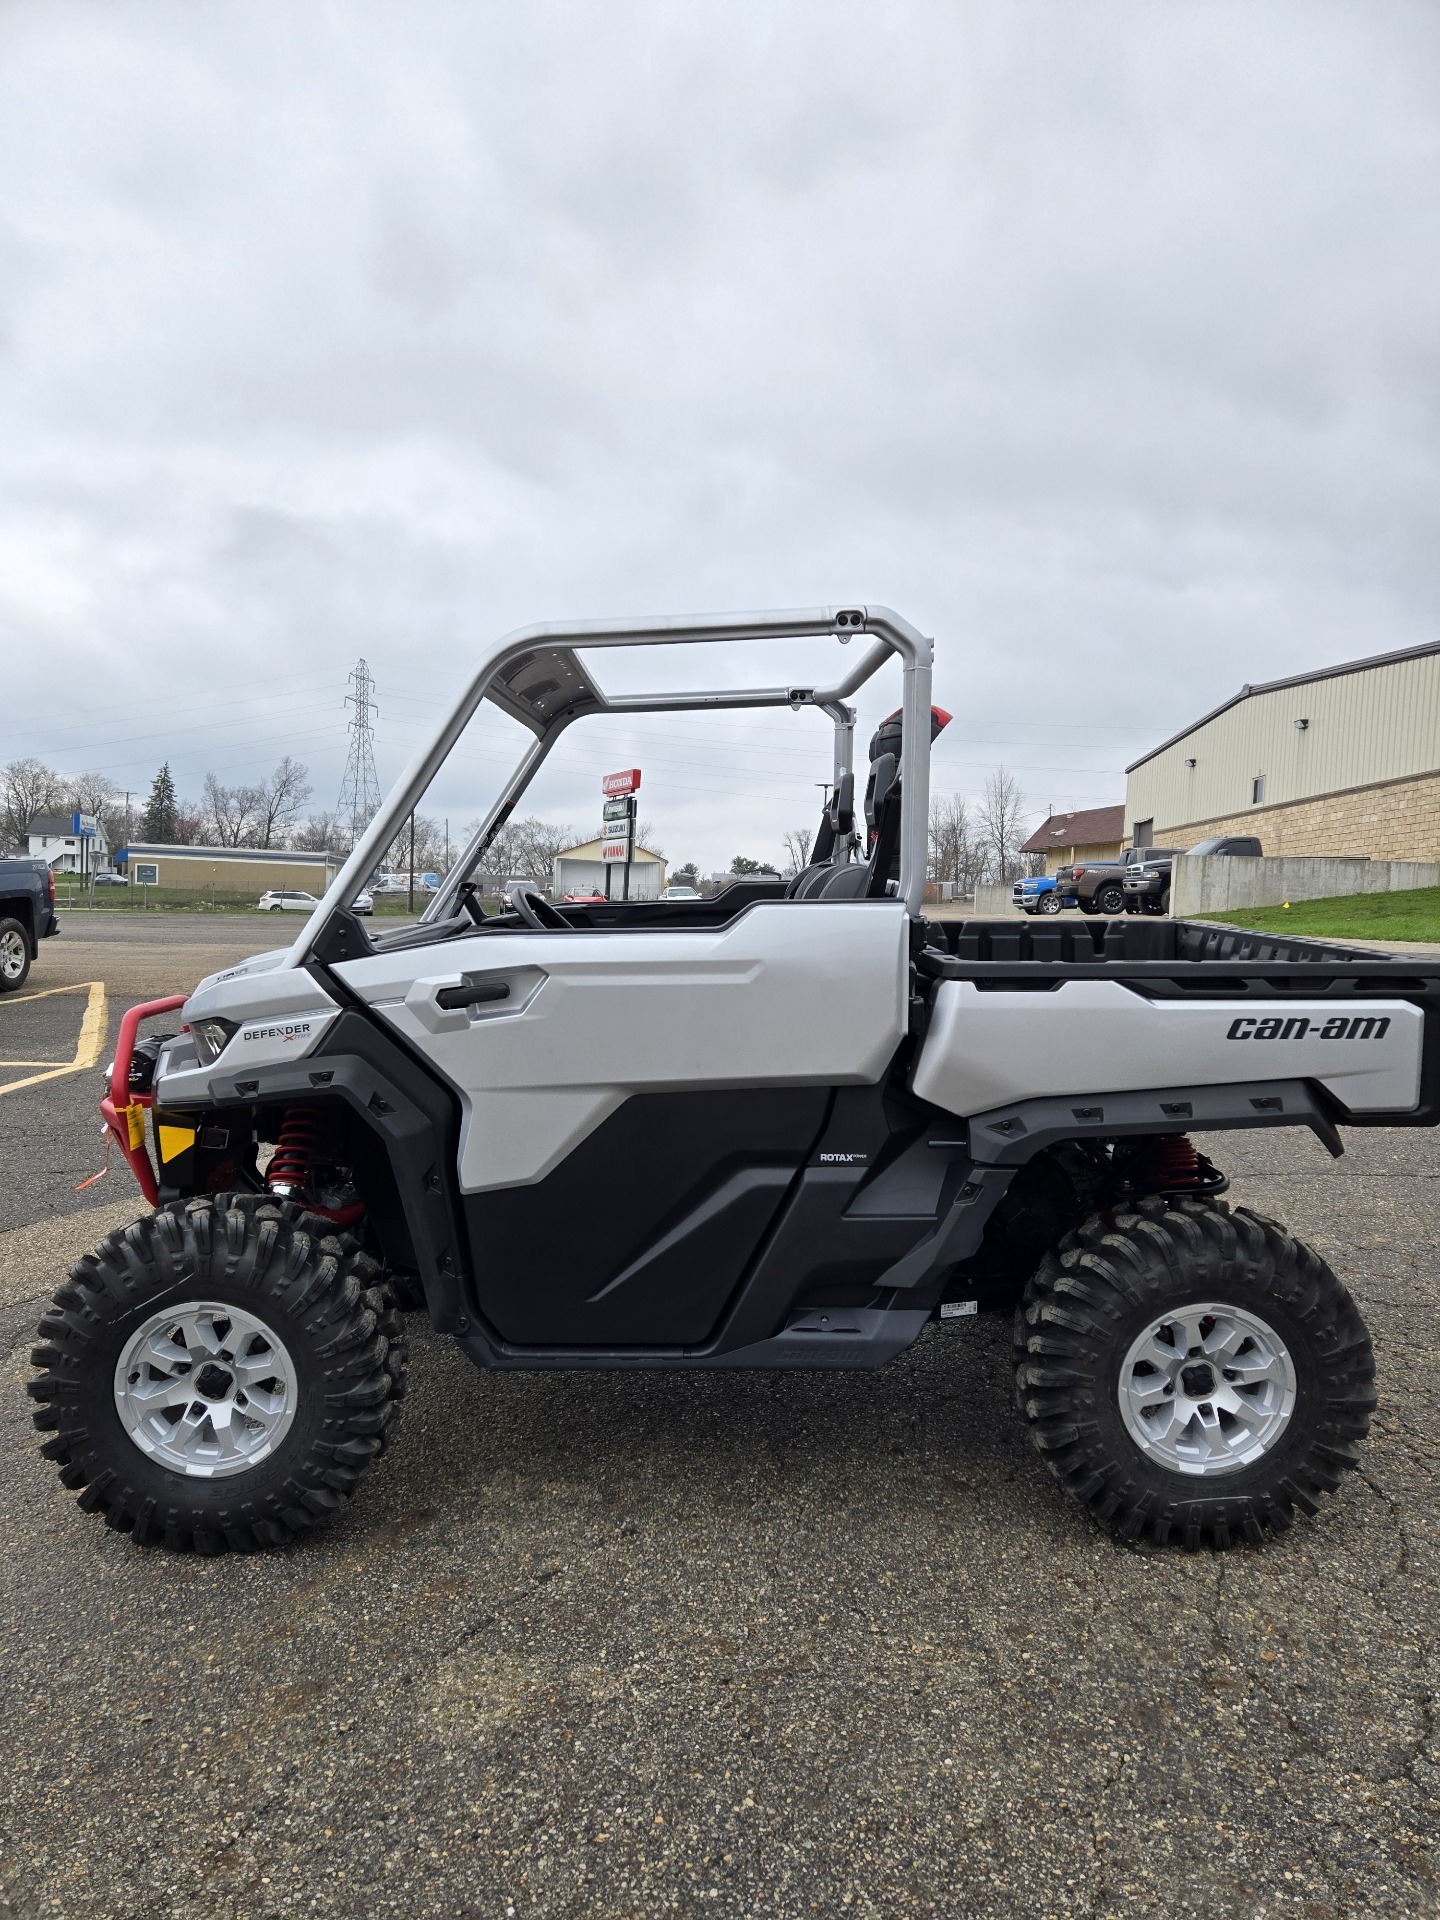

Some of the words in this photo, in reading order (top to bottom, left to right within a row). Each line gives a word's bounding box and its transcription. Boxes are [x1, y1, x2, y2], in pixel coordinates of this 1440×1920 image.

[609, 776, 632, 788] HONDA
[608, 824, 625, 833] SUZUKI
[608, 845, 624, 857] YAMAHA
[244, 1024, 310, 1041] DEFENDER
[1226, 1017, 1391, 1040] can-am
[820, 1153, 853, 1161] ROTAX
